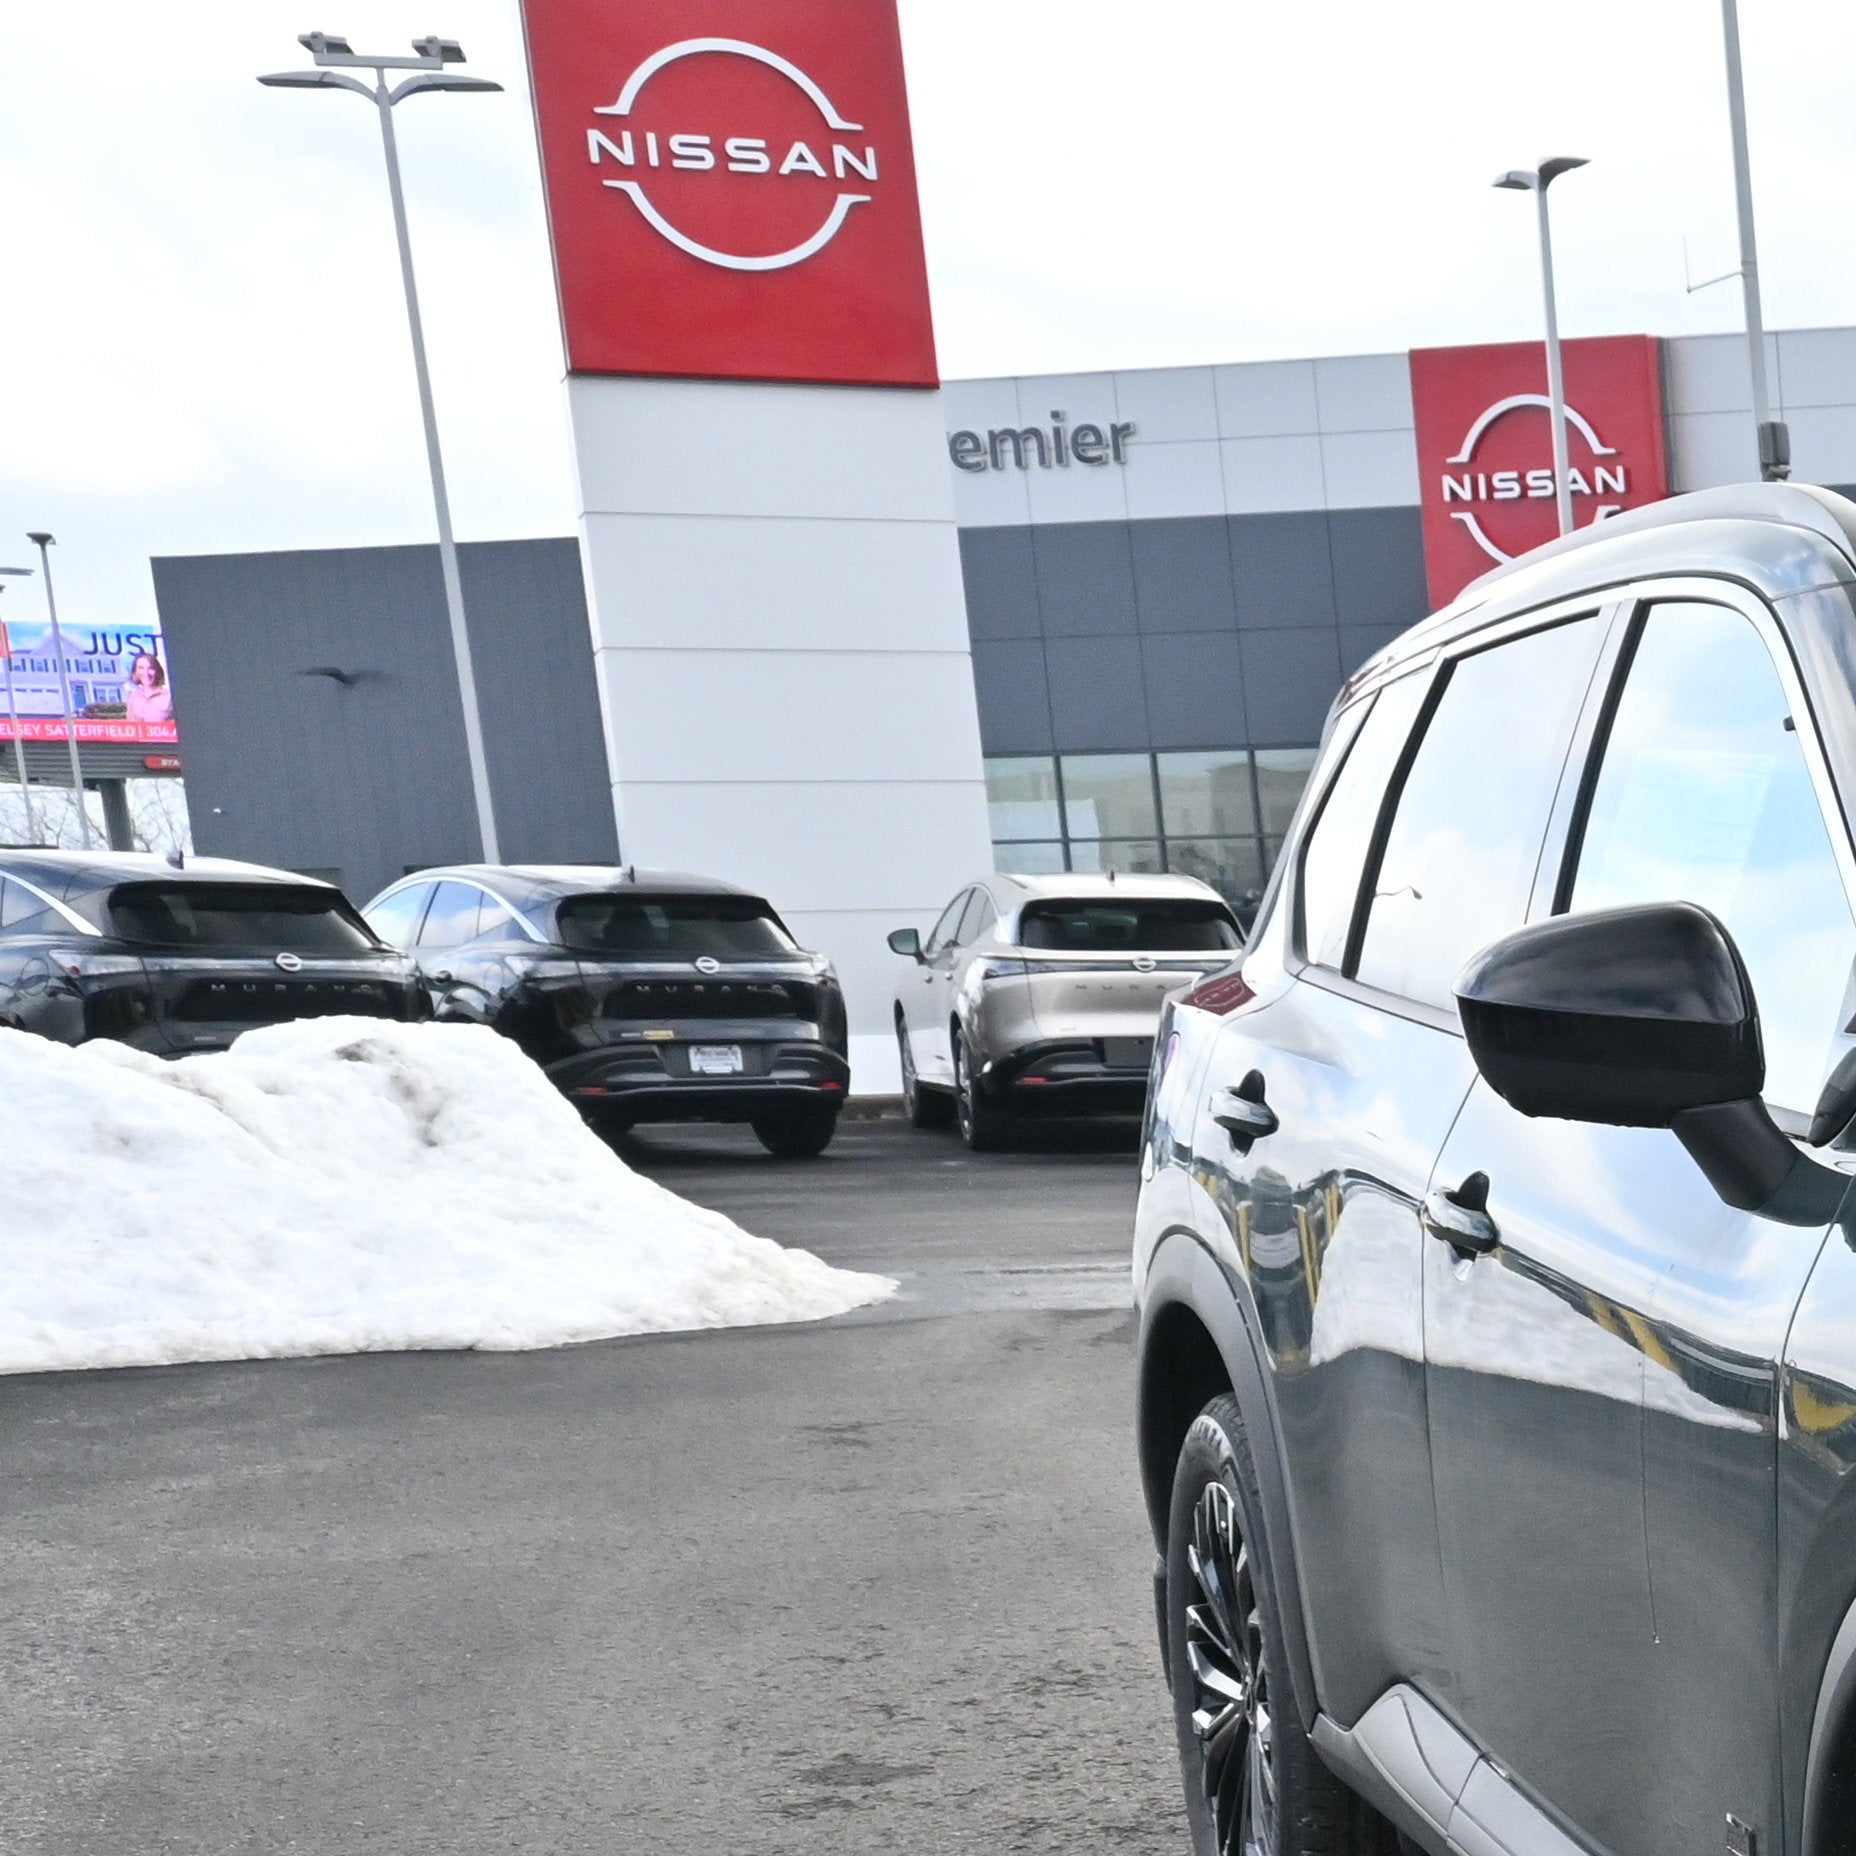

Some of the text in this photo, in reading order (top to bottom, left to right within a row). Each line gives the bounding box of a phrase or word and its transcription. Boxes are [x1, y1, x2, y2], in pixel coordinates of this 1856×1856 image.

[586, 128, 879, 181] NISSAN
[946, 409, 1137, 473] emier
[1441, 464, 1627, 503] NISSAN
[83, 631, 164, 658] JUST
[44, 723, 136, 738] SATTERFIELD
